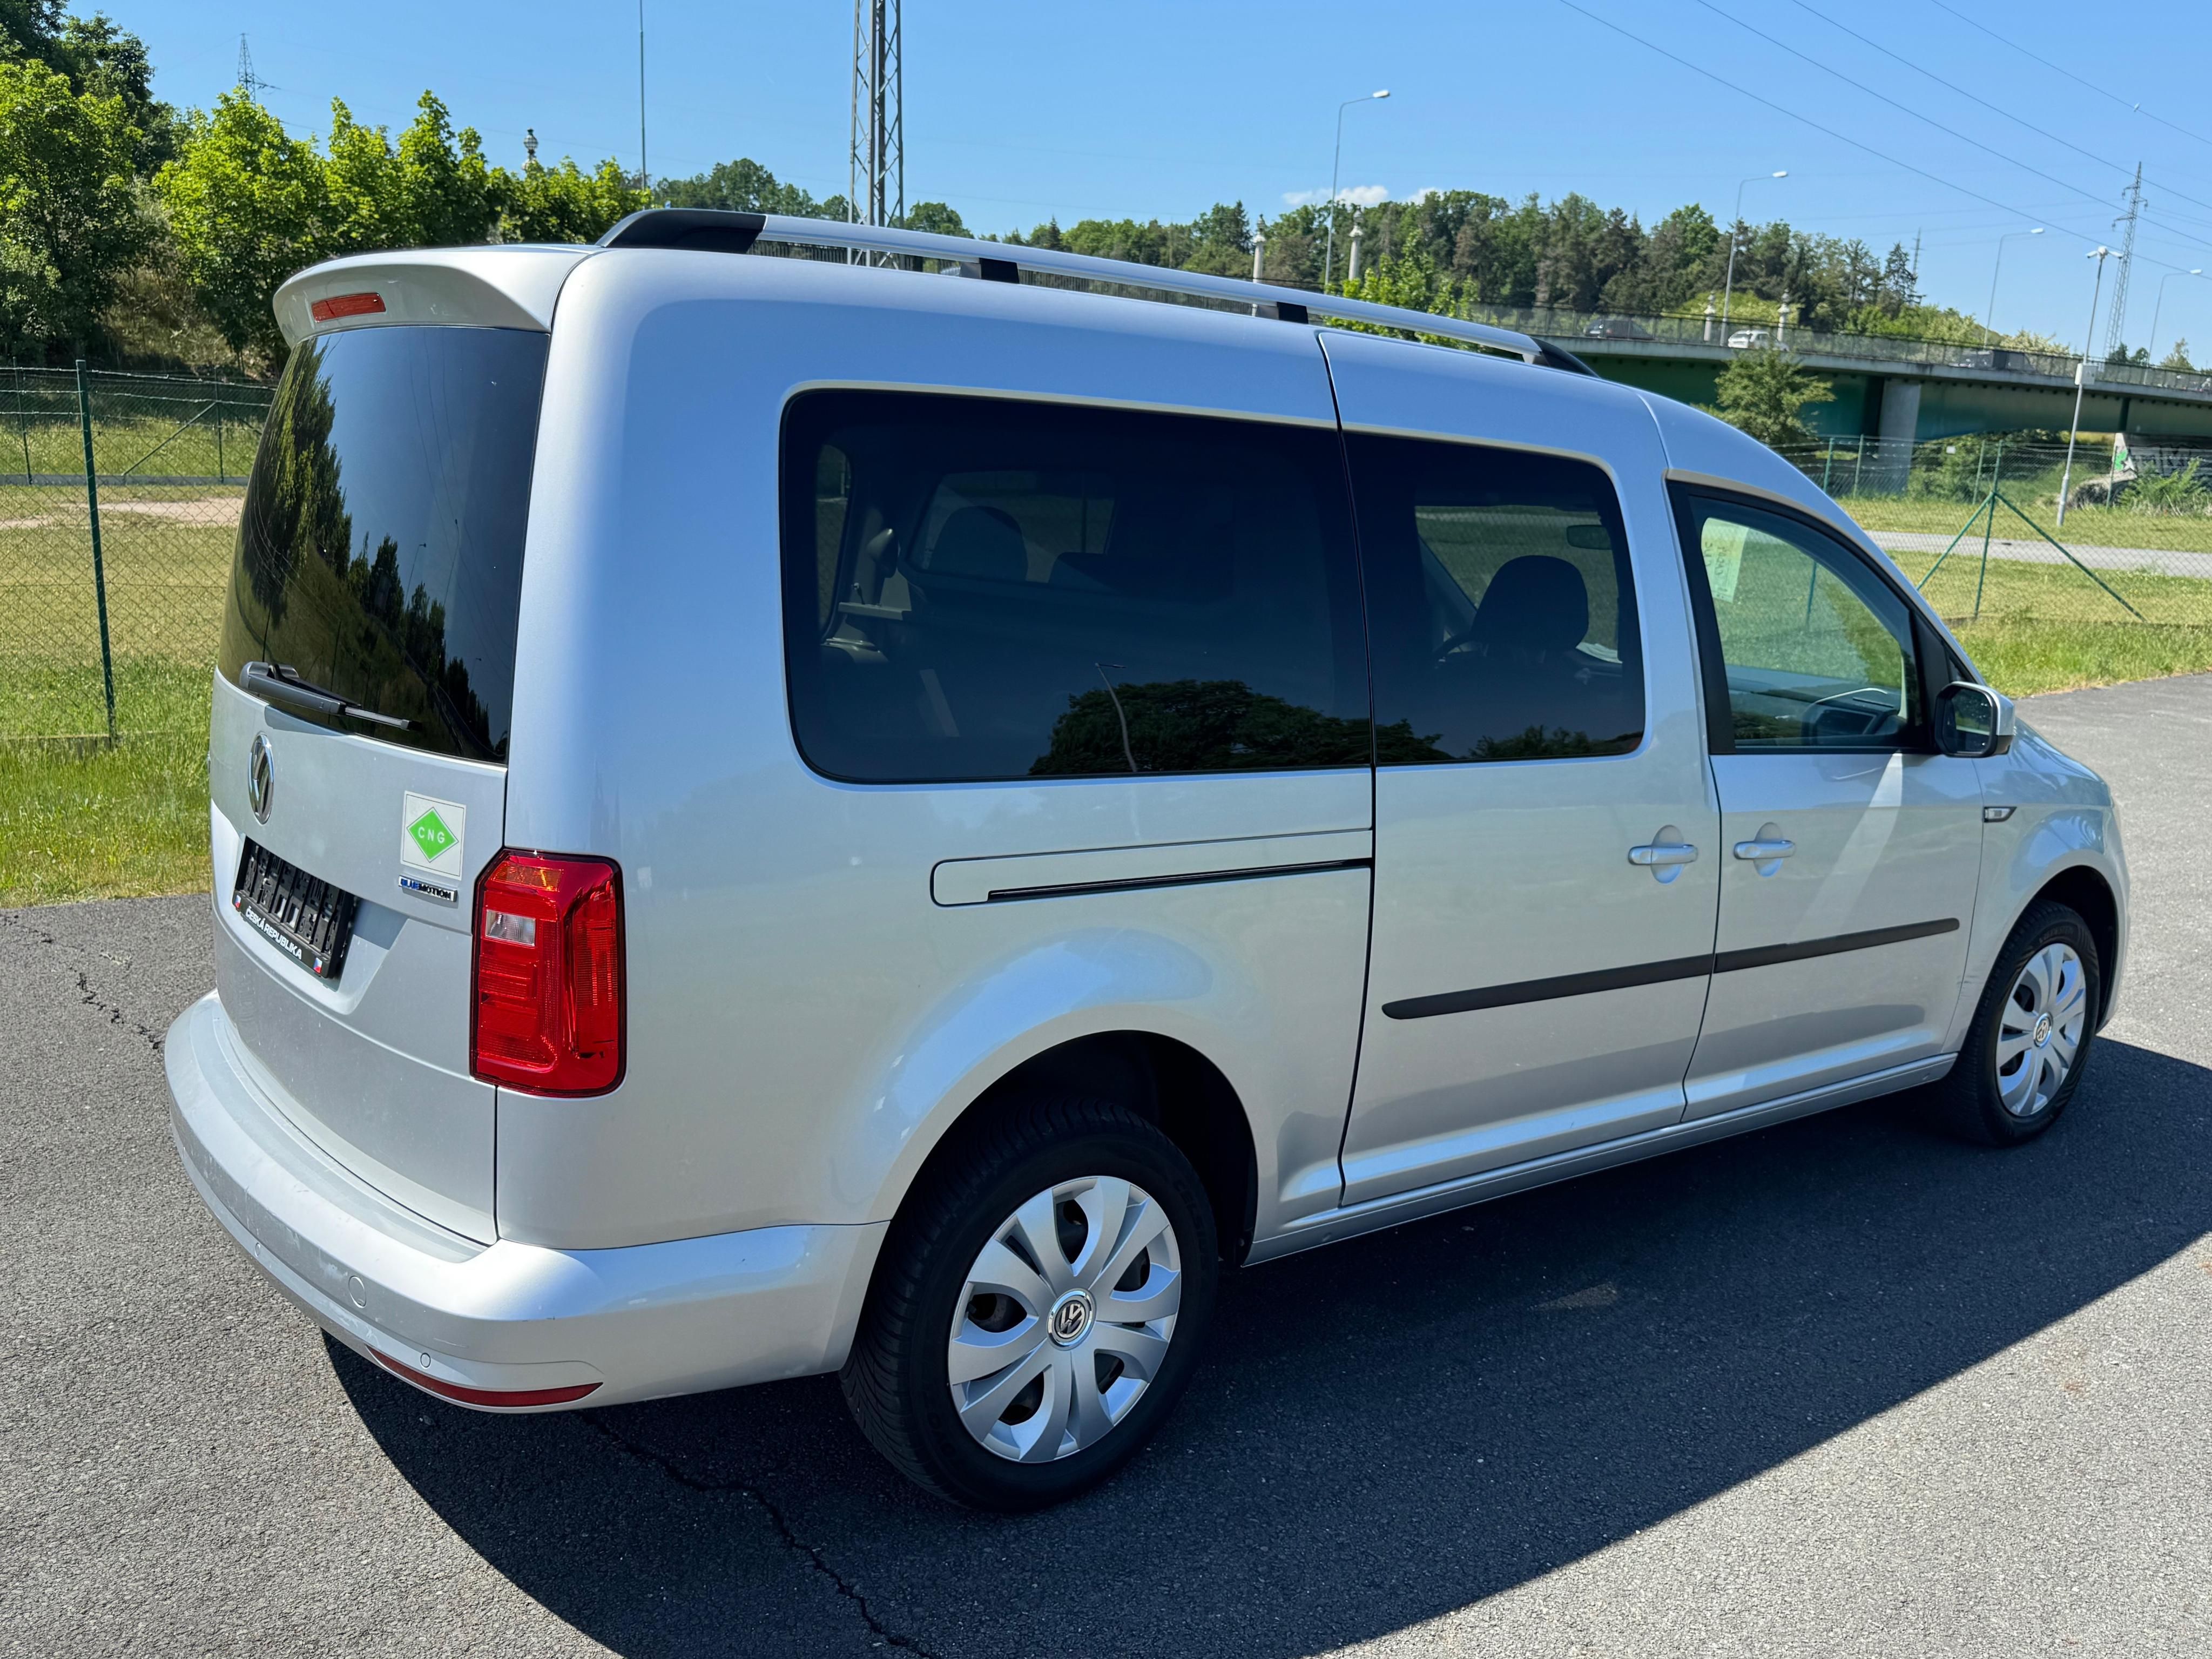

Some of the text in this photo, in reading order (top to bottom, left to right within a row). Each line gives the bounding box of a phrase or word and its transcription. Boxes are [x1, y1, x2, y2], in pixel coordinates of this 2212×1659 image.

[418, 826, 445, 844] CNG
[245, 905, 302, 960] ČESKÁ REPUBLIKA
